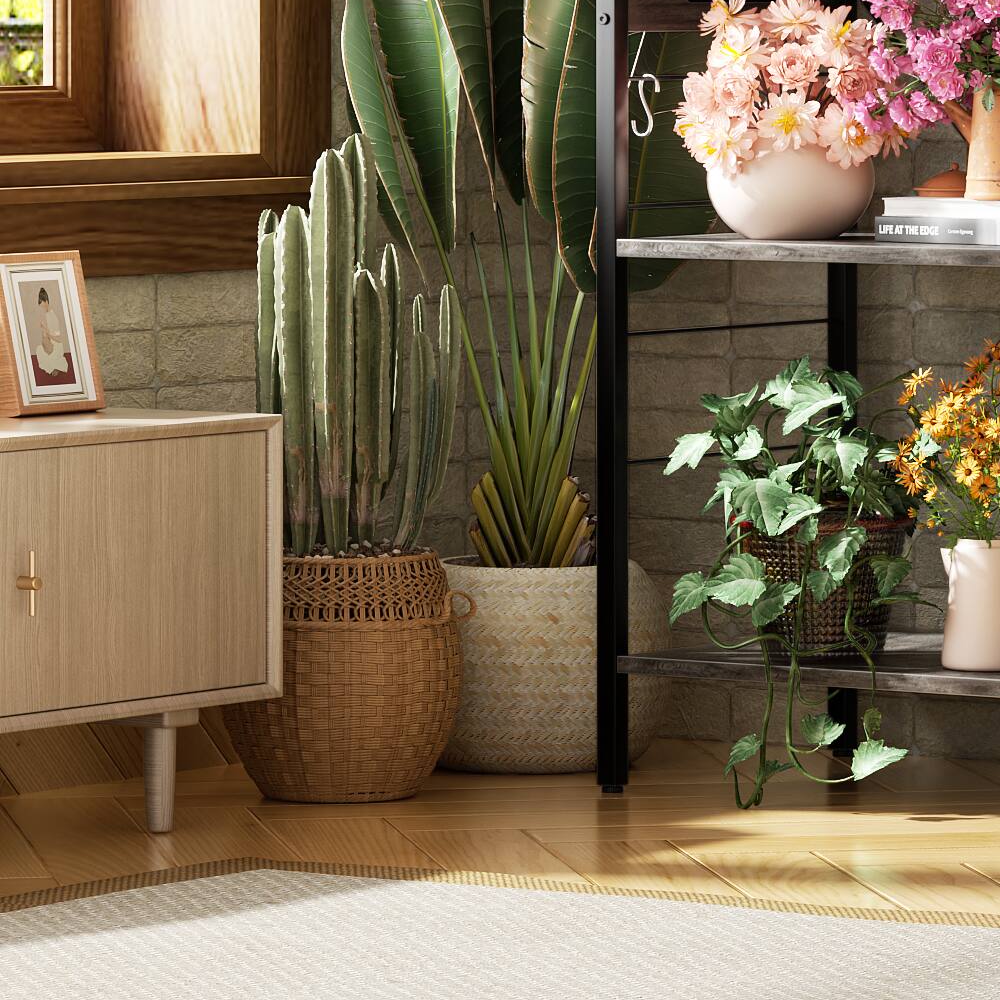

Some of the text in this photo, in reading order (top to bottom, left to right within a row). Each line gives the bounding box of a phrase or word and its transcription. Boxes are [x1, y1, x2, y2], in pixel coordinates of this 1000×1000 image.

[878, 224, 894, 235] LIFE
[894, 224, 904, 235] AT
[904, 225, 919, 236] THE
[919, 225, 939, 236] EDGE
